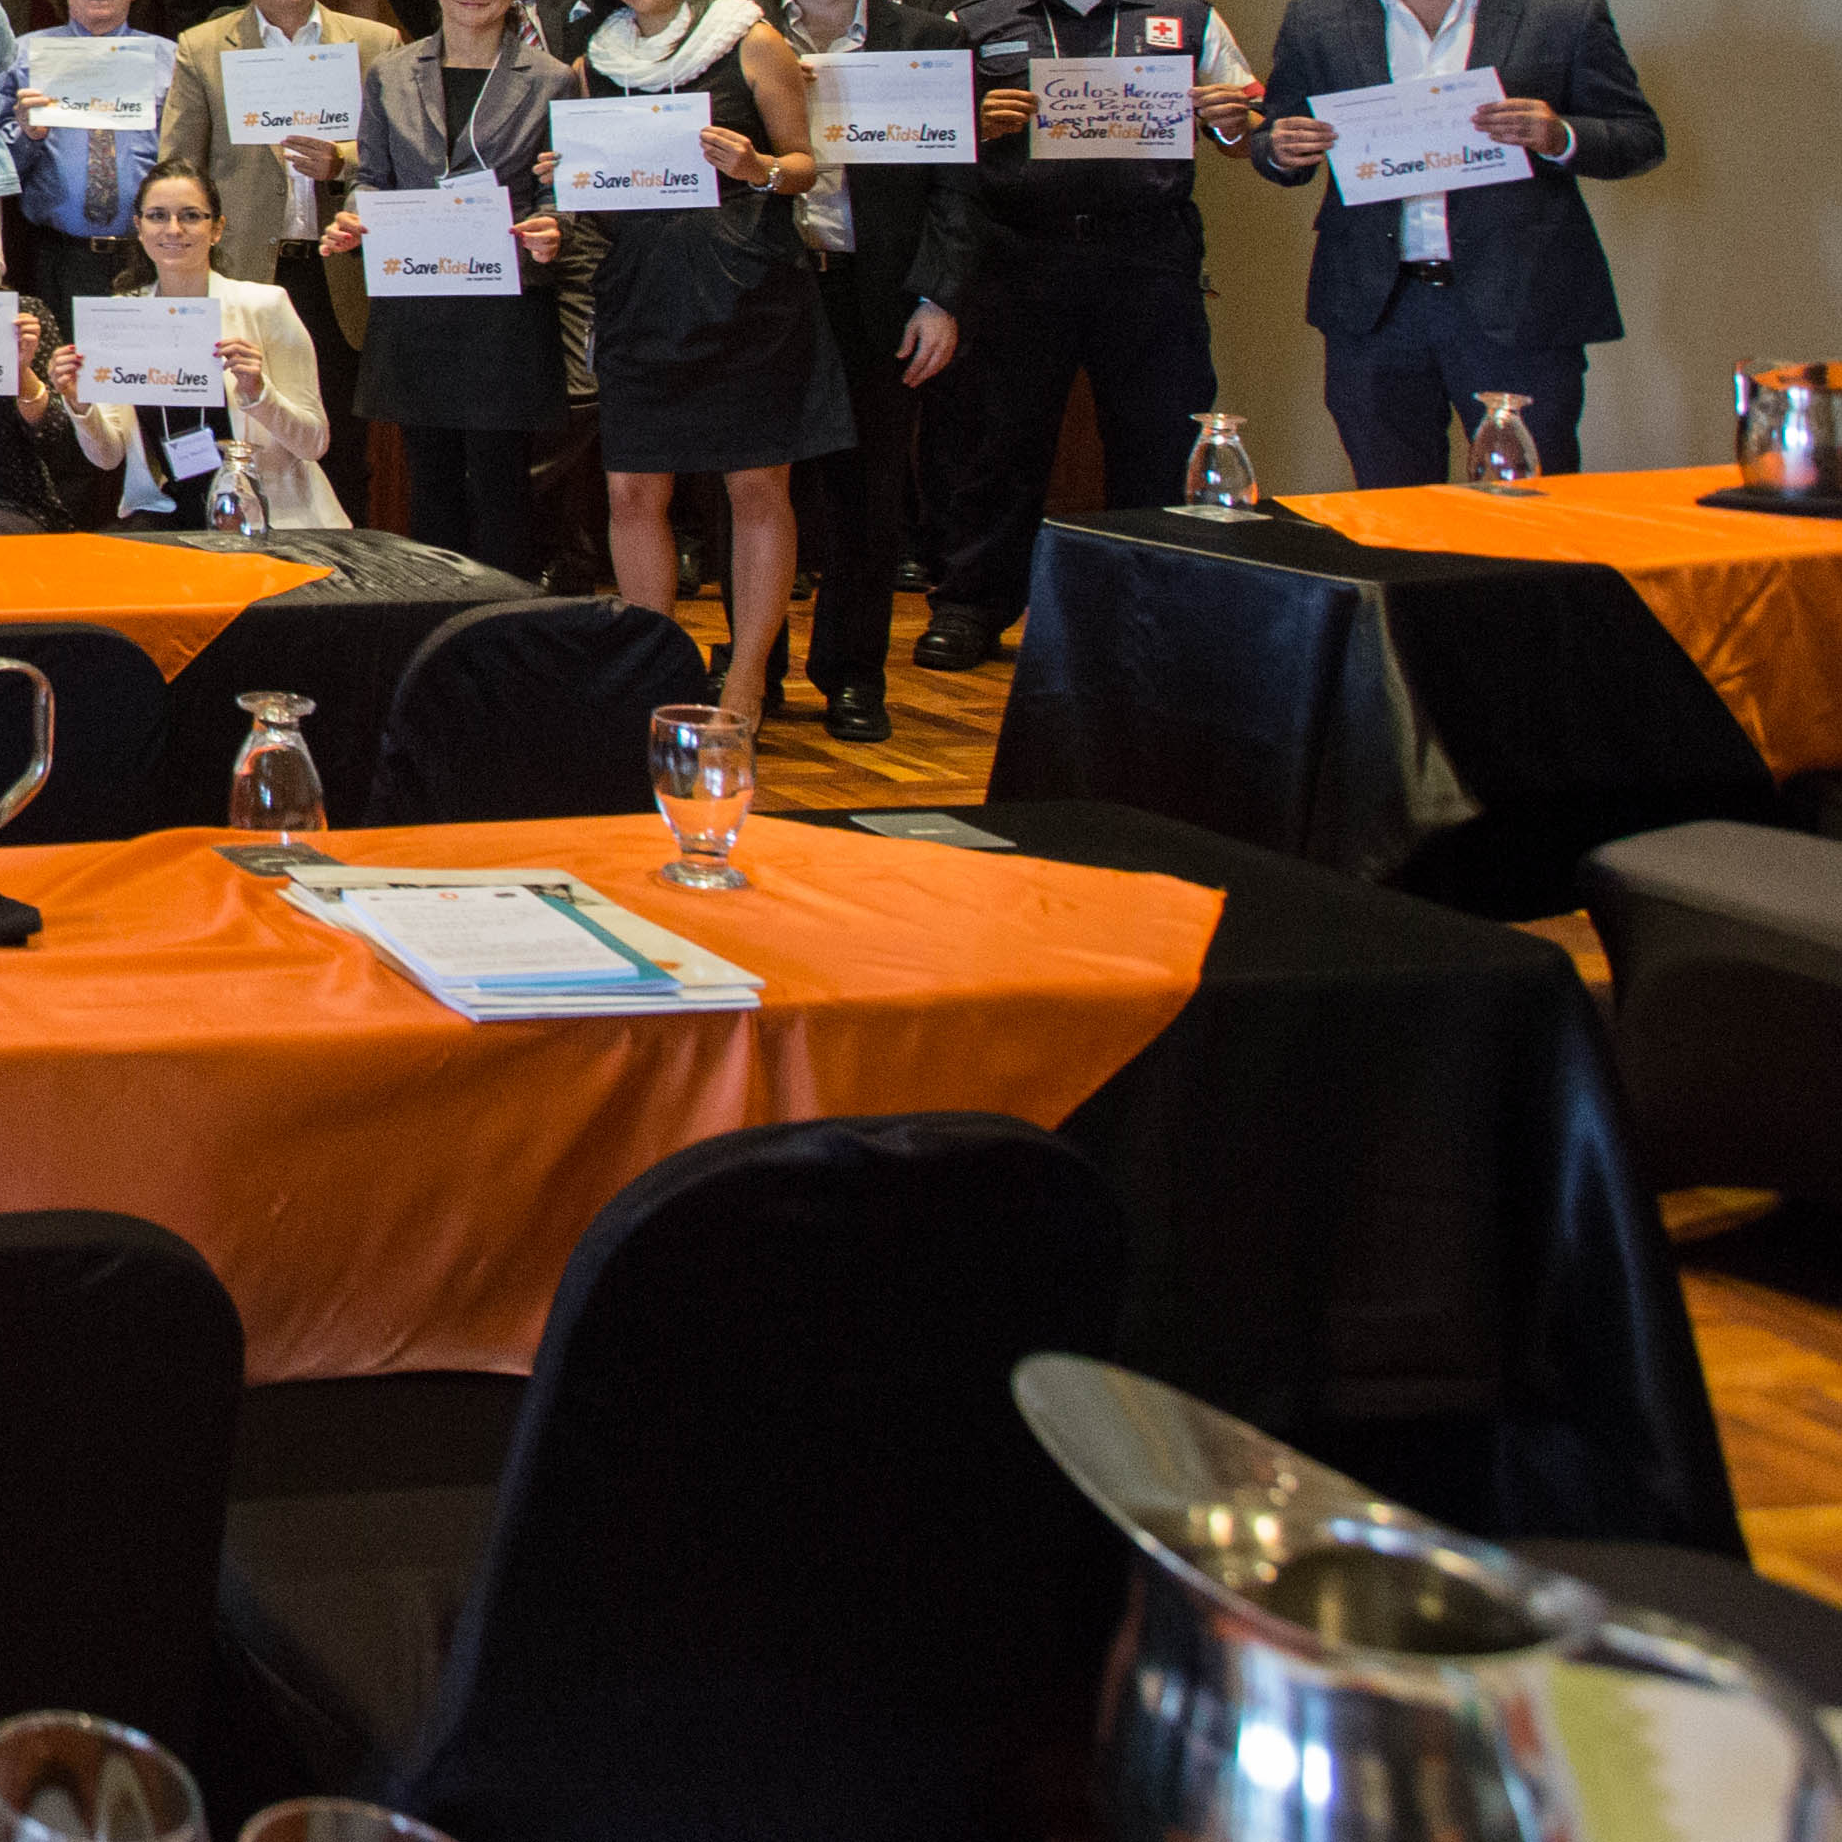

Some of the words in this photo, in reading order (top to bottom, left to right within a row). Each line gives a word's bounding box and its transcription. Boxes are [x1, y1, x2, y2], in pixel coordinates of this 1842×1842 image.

[1044, 78, 1118, 99] Carlos
[823, 123, 957, 144] #SaveKidsLives
[1355, 145, 1506, 181] #SaveKidsLives
[571, 169, 698, 189] #SaveKidsLives
[382, 257, 502, 278] #SaveKidsLives
[93, 367, 208, 386] #SaveKidsLives
